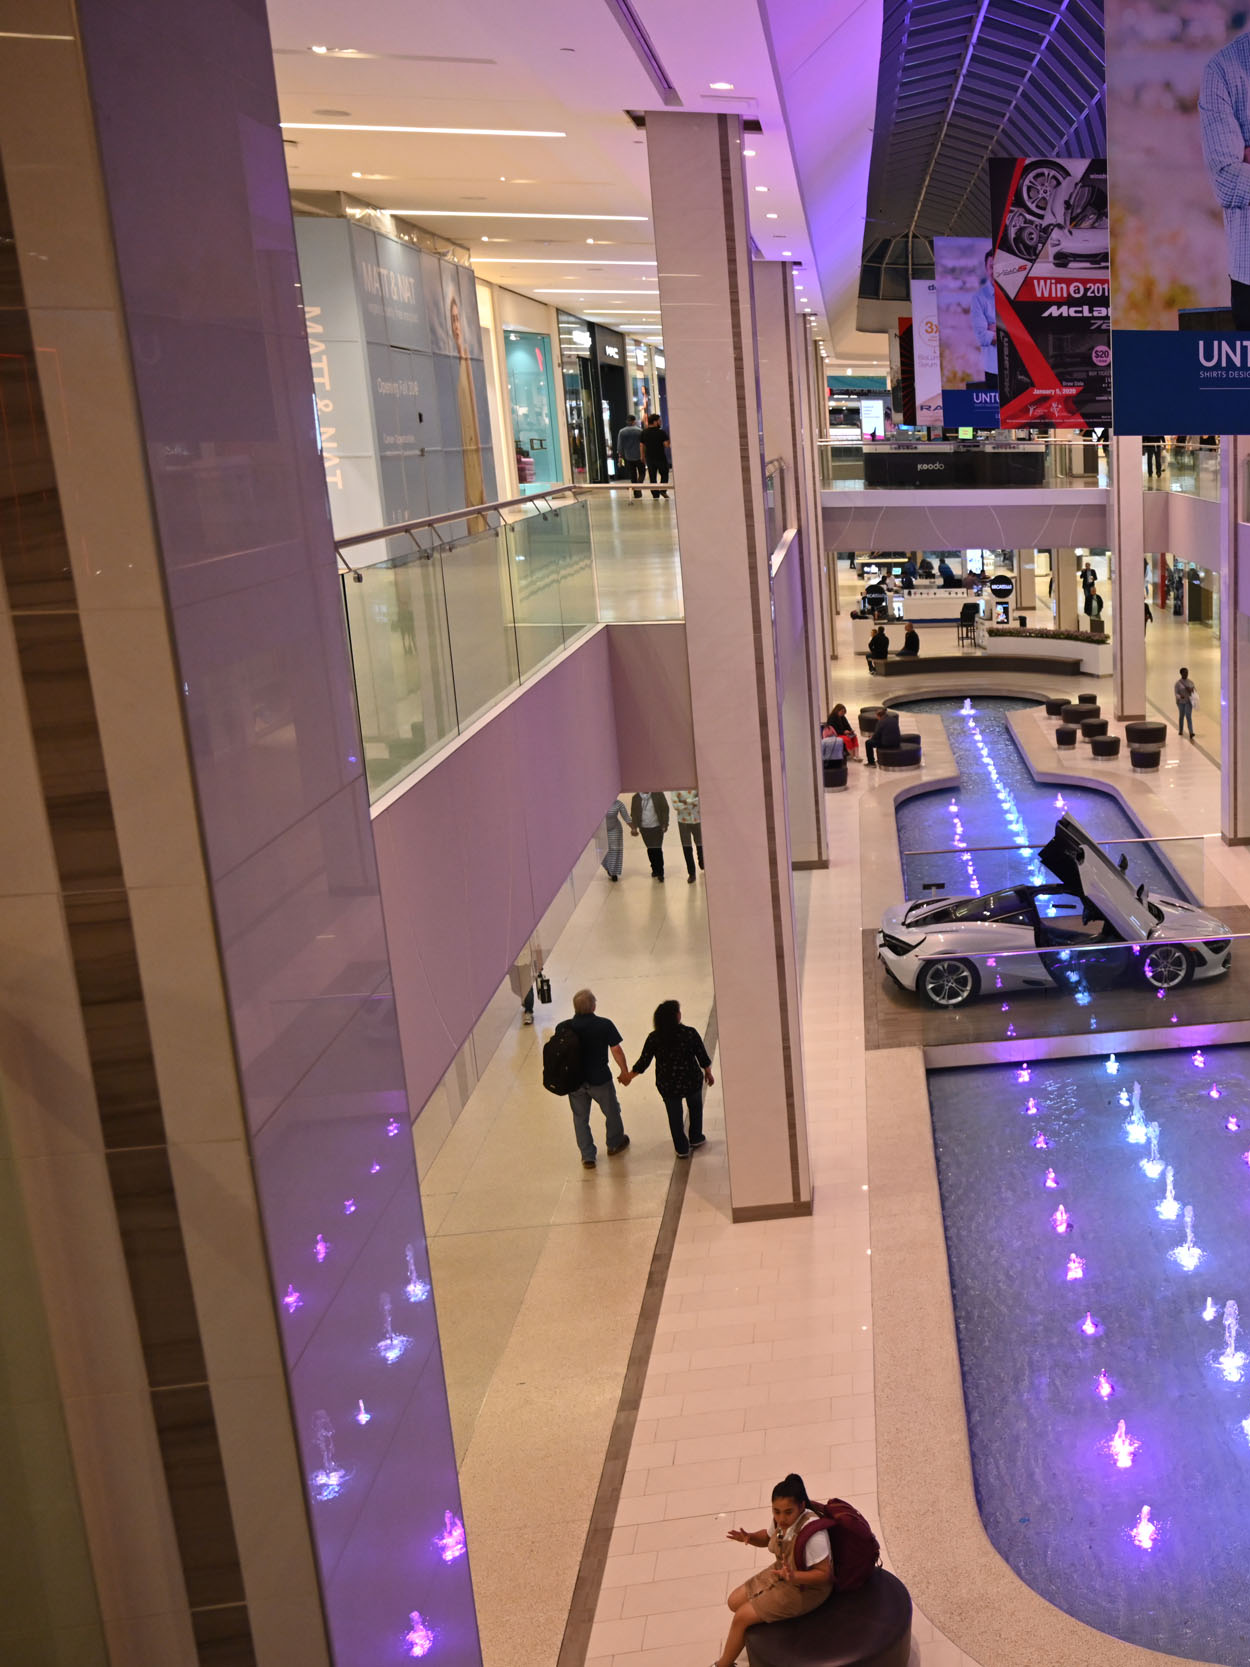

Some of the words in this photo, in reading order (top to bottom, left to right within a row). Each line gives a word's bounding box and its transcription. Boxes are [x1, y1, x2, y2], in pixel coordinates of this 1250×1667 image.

[1033, 279, 1067, 298] Win
[1094, 349, 1110, 360] $20
[1199, 371, 1227, 379] SHIRTS
[304, 306, 331, 391] MATT
[320, 427, 343, 489] NAT
[917, 461, 945, 471] koodo
